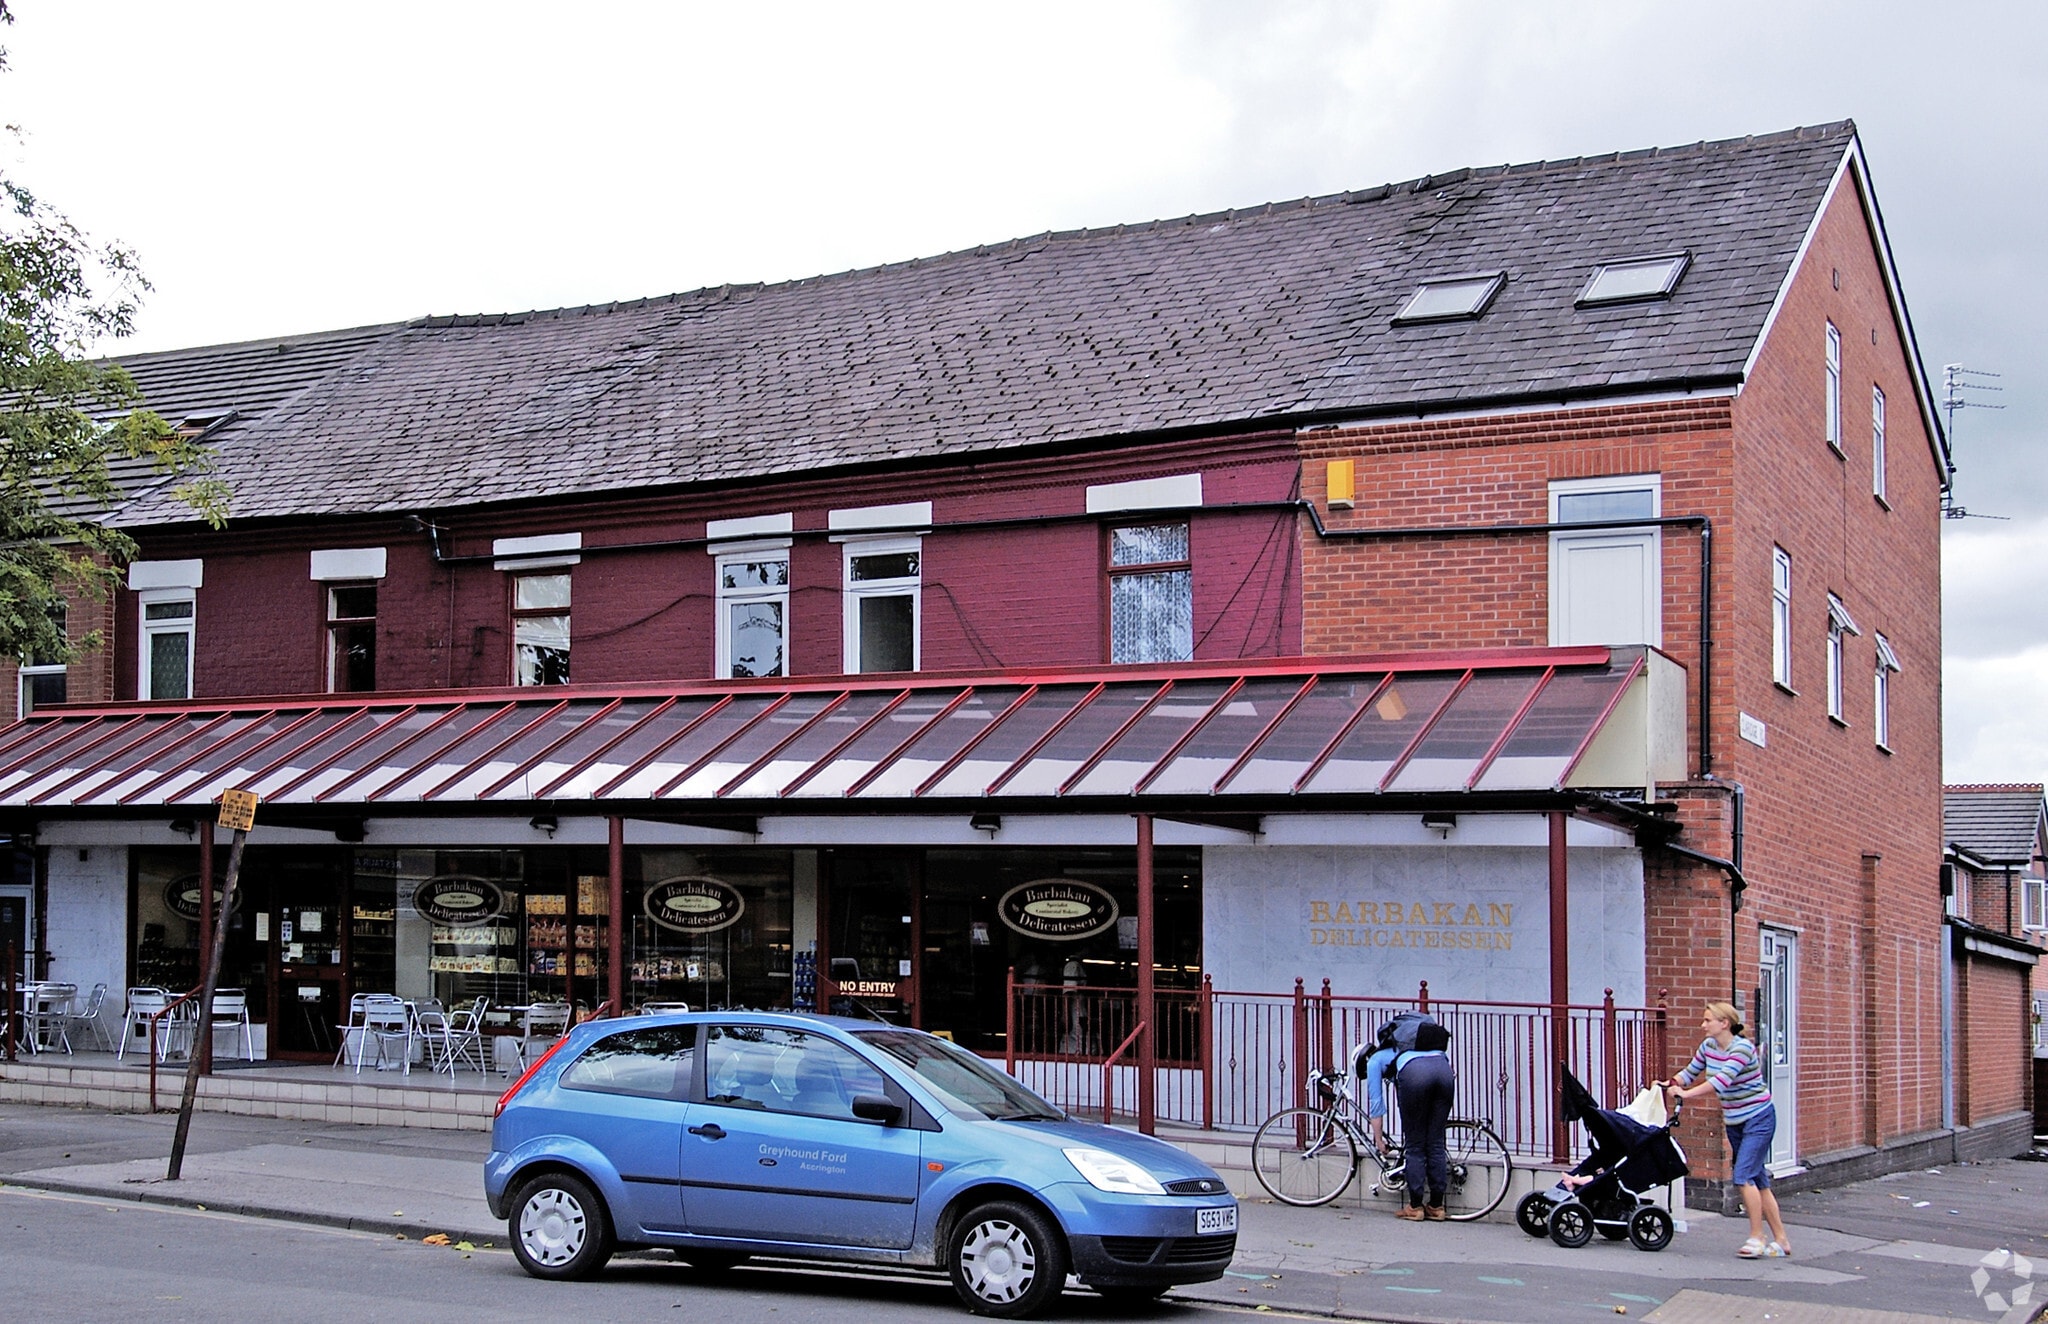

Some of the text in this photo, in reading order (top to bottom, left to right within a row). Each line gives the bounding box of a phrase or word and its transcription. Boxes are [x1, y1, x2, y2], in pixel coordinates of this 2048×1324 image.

[435, 881, 484, 895] Barbakan
[667, 882, 721, 899] Barbakan
[1025, 886, 1091, 903] Barbakan
[429, 904, 488, 920] Delicatessen
[660, 907, 726, 925] Delicatessen
[1309, 900, 1513, 927] BARBAKAN
[1019, 912, 1097, 932] Delicatessen
[1310, 928, 1513, 950] DELICATESSEN
[839, 981, 896, 993] NO ENTRY
[759, 1143, 847, 1163] Greyhound Ford
[800, 1162, 846, 1174] Accrington
[1201, 1211, 1221, 1228] SG53
